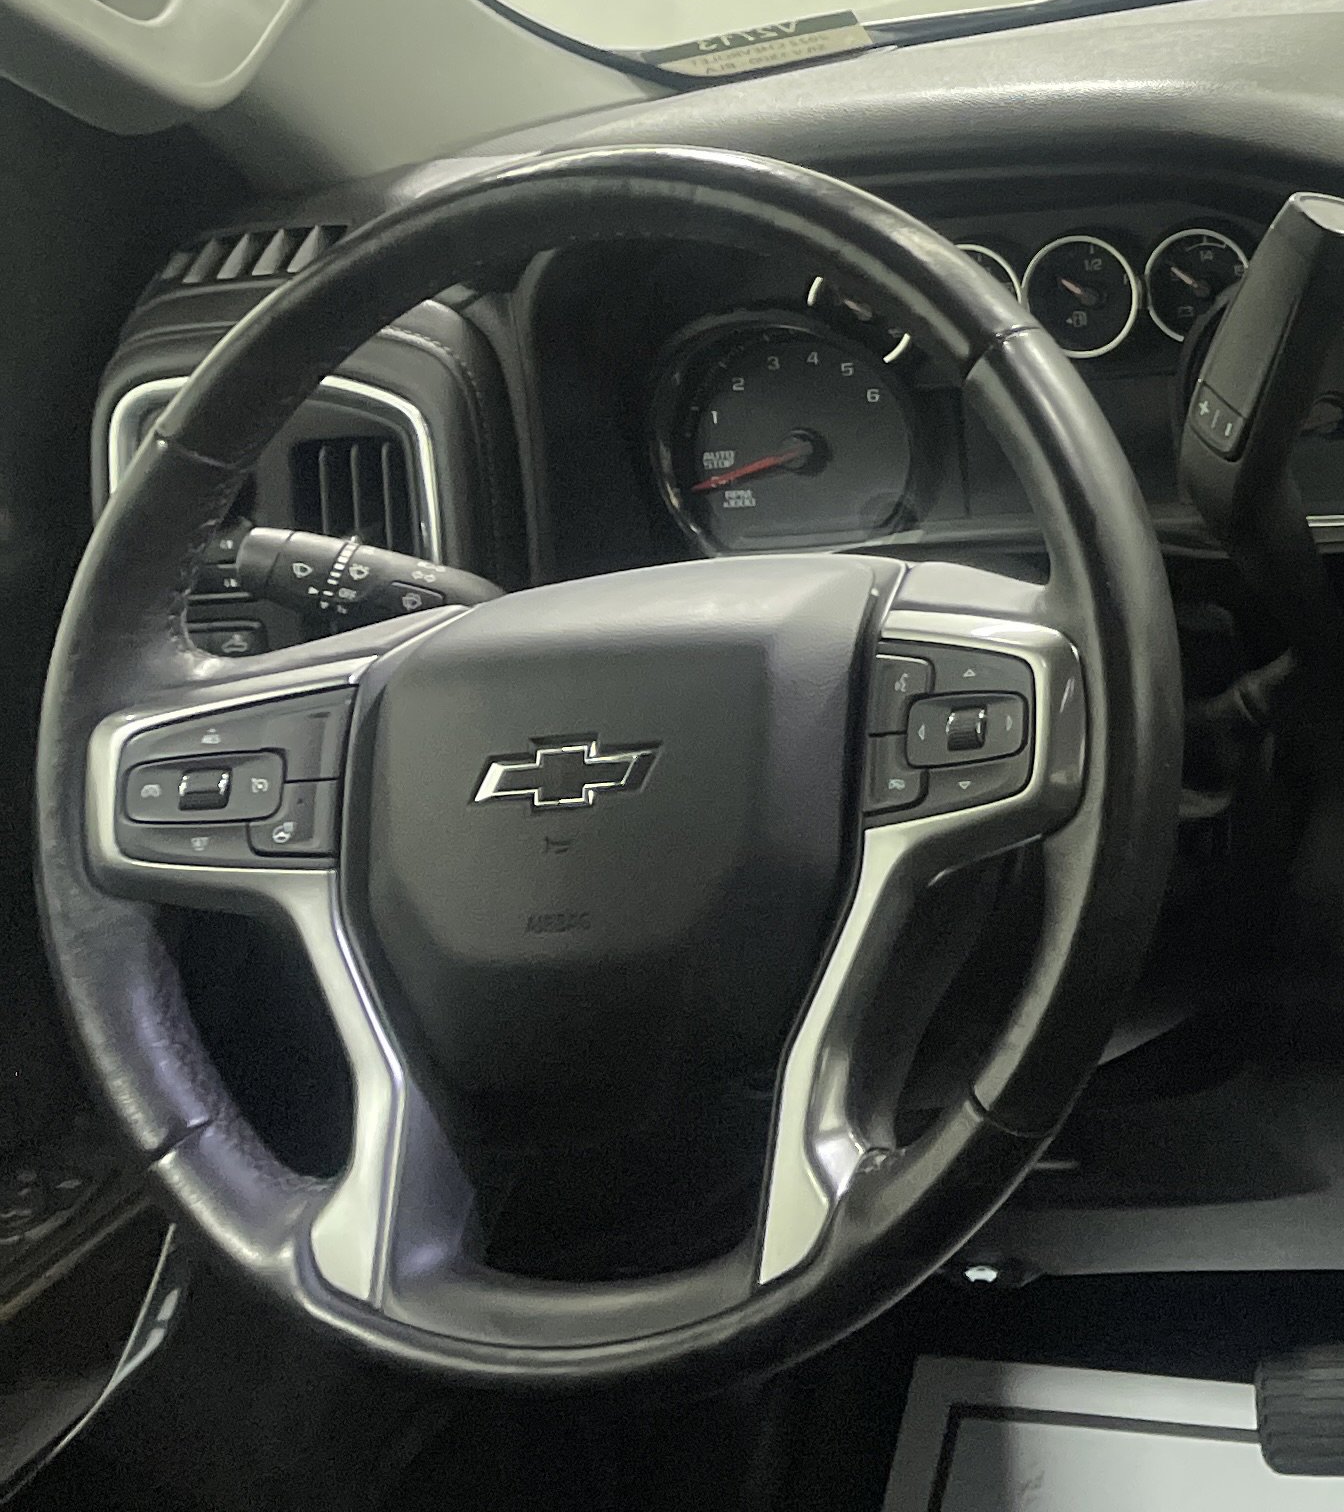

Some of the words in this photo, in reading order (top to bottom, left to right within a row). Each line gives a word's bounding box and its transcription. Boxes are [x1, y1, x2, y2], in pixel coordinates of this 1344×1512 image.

[767, 356, 780, 370] 3
[805, 351, 819, 365] 4
[841, 362, 854, 376] 5
[732, 377, 745, 391] 2
[866, 388, 880, 402] 6
[711, 410, 718, 424] 1
